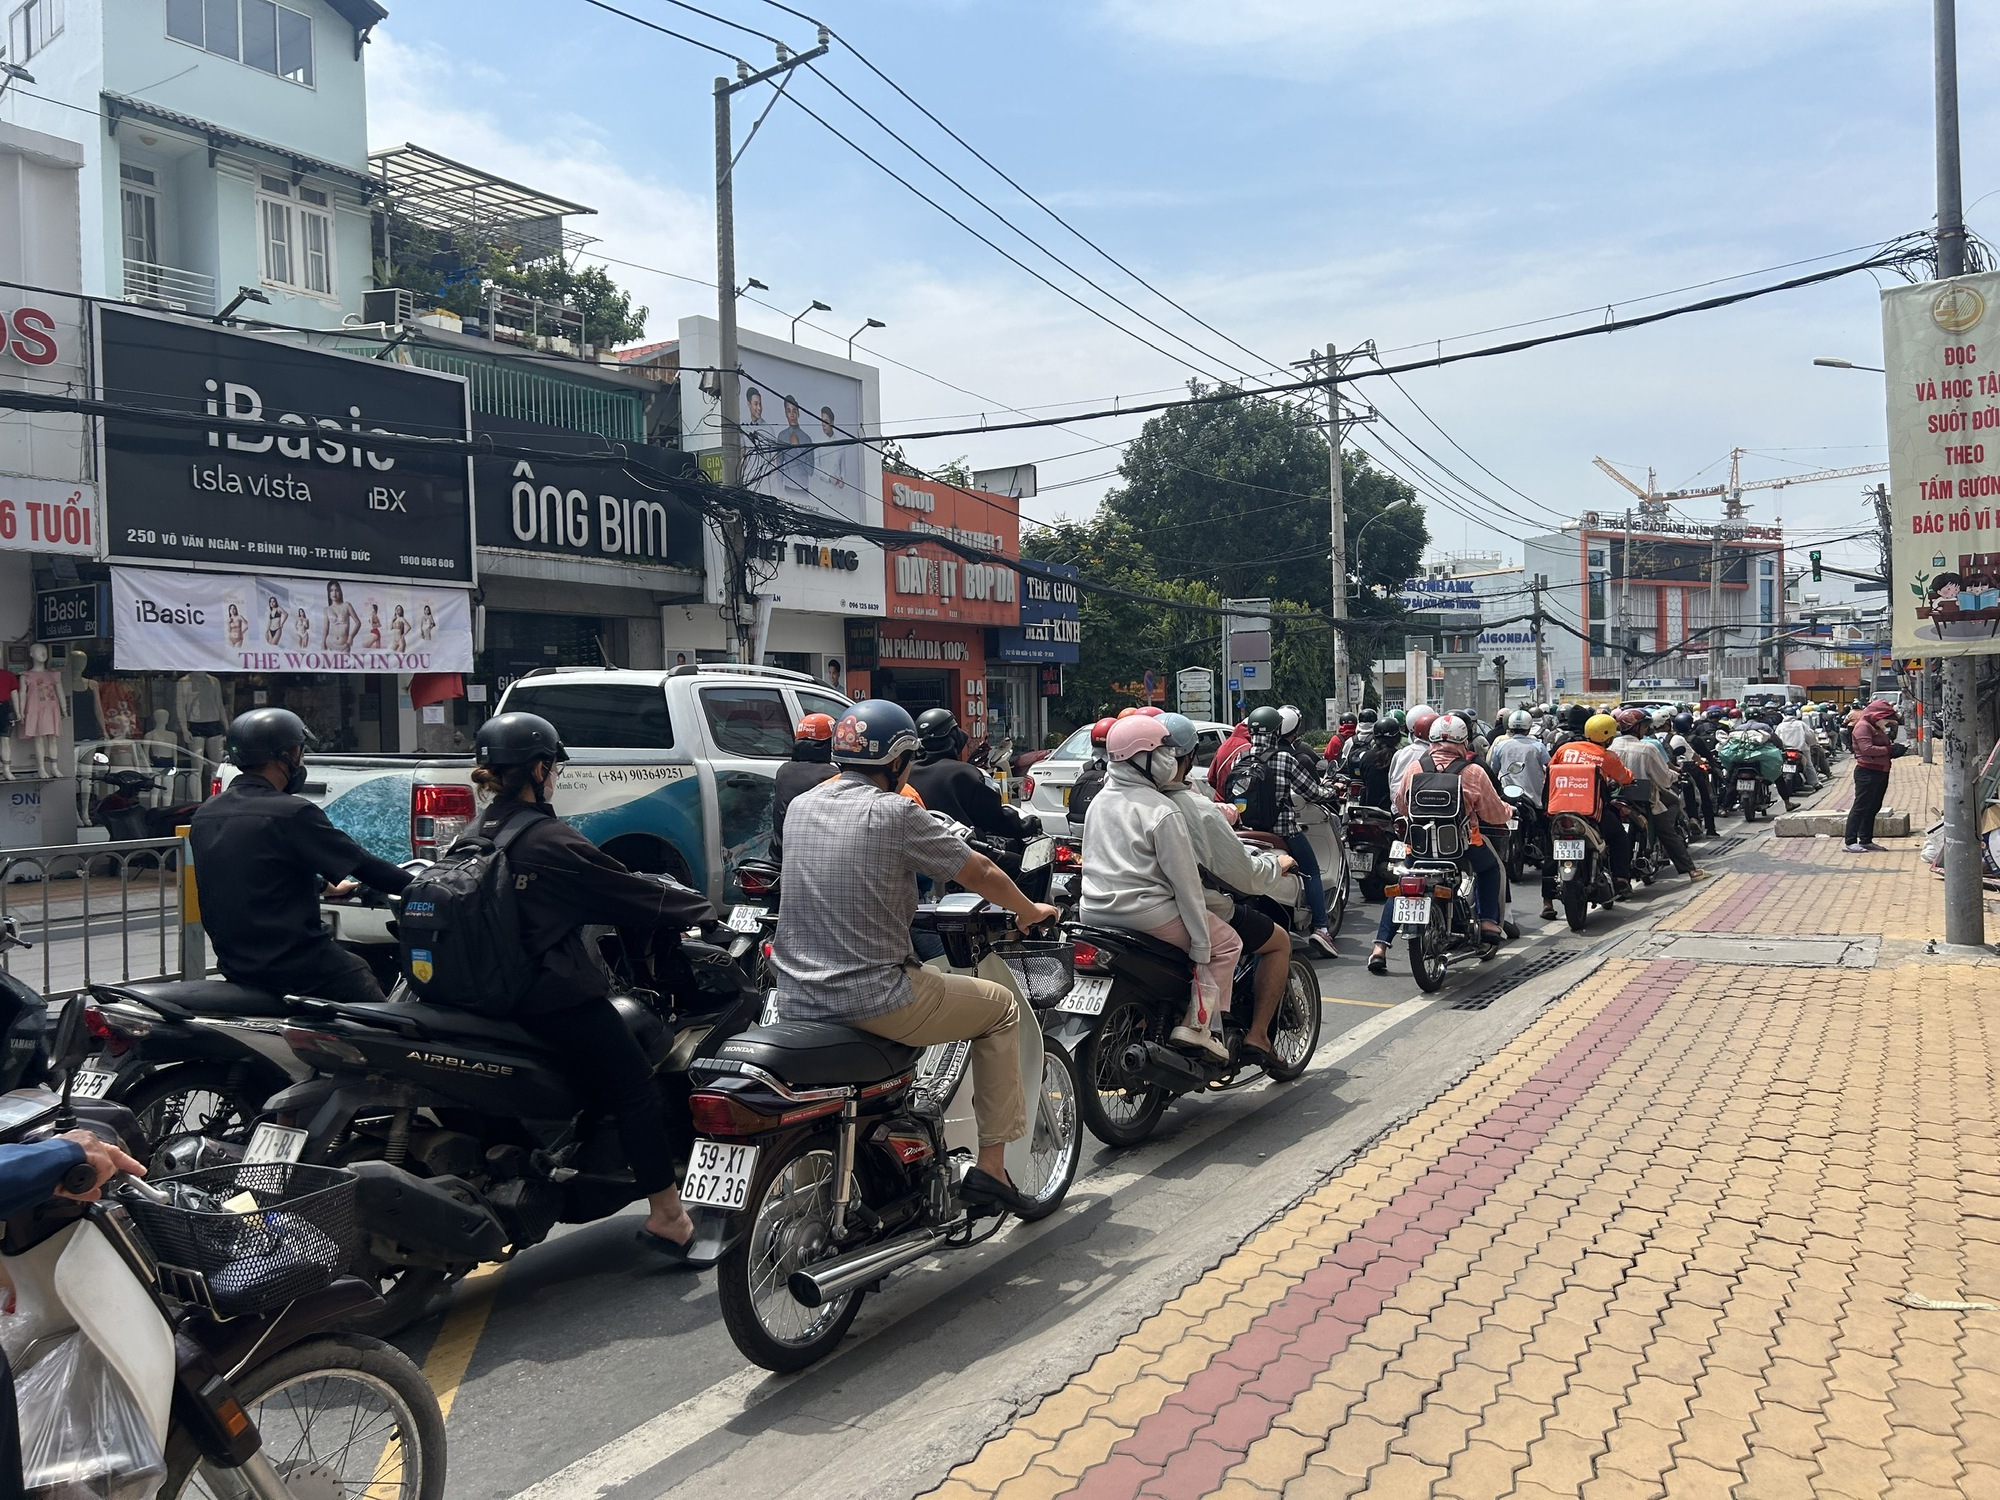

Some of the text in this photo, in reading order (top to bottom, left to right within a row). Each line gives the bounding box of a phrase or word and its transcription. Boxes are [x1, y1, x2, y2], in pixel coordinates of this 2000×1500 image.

[0, 308, 57, 365] S
[1944, 344, 1976, 369] ĐỌC
[1916, 371, 2000, 402] VÀ HỌC TẬ
[1928, 404, 2000, 433] SUỐT ĐỜI
[1945, 444, 1984, 465] THEO
[193, 464, 243, 494] isla
[248, 473, 312, 501] vista
[1919, 474, 2000, 500] TẤM GƯƠN
[892, 483, 934, 512] Shop
[26, 490, 91, 545] TUỔI
[1912, 511, 1944, 534] BÁC
[1949, 506, 1970, 532] HỒ
[1975, 506, 1990, 530] VĨ
[127, 528, 156, 544] 250
[161, 532, 177, 546] VÕ
[181, 534, 204, 548] VĂN
[208, 537, 239, 551] NGÂN
[288, 545, 307, 558] THỌ
[351, 549, 371, 561] ĐỨC
[399, 555, 419, 566] 1900
[994, 566, 1015, 603] DA
[44, 593, 88, 623] iBasic
[135, 599, 205, 625] iBasic
[1053, 613, 1081, 643] KÍNH
[894, 629, 926, 660] PHẨM
[926, 641, 941, 660] DA
[943, 641, 969, 661] 100%
[239, 652, 431, 670] THE WOMEN IN YOU
[573, 782, 588, 790] City
[574, 771, 595, 779] Ward,
[598, 770, 628, 785] (+84)
[629, 767, 684, 781] 903649251
[1568, 781, 1588, 789] Food
[1398, 911, 1425, 922] 0510
[406, 1051, 513, 1075] AIRBLADE
[723, 1046, 755, 1054] HONDA
[881, 1078, 902, 1090] HONDA
[255, 1129, 297, 1160] 71-B4
[698, 1144, 746, 1174] 59-X1
[685, 1173, 746, 1204] 667.36
